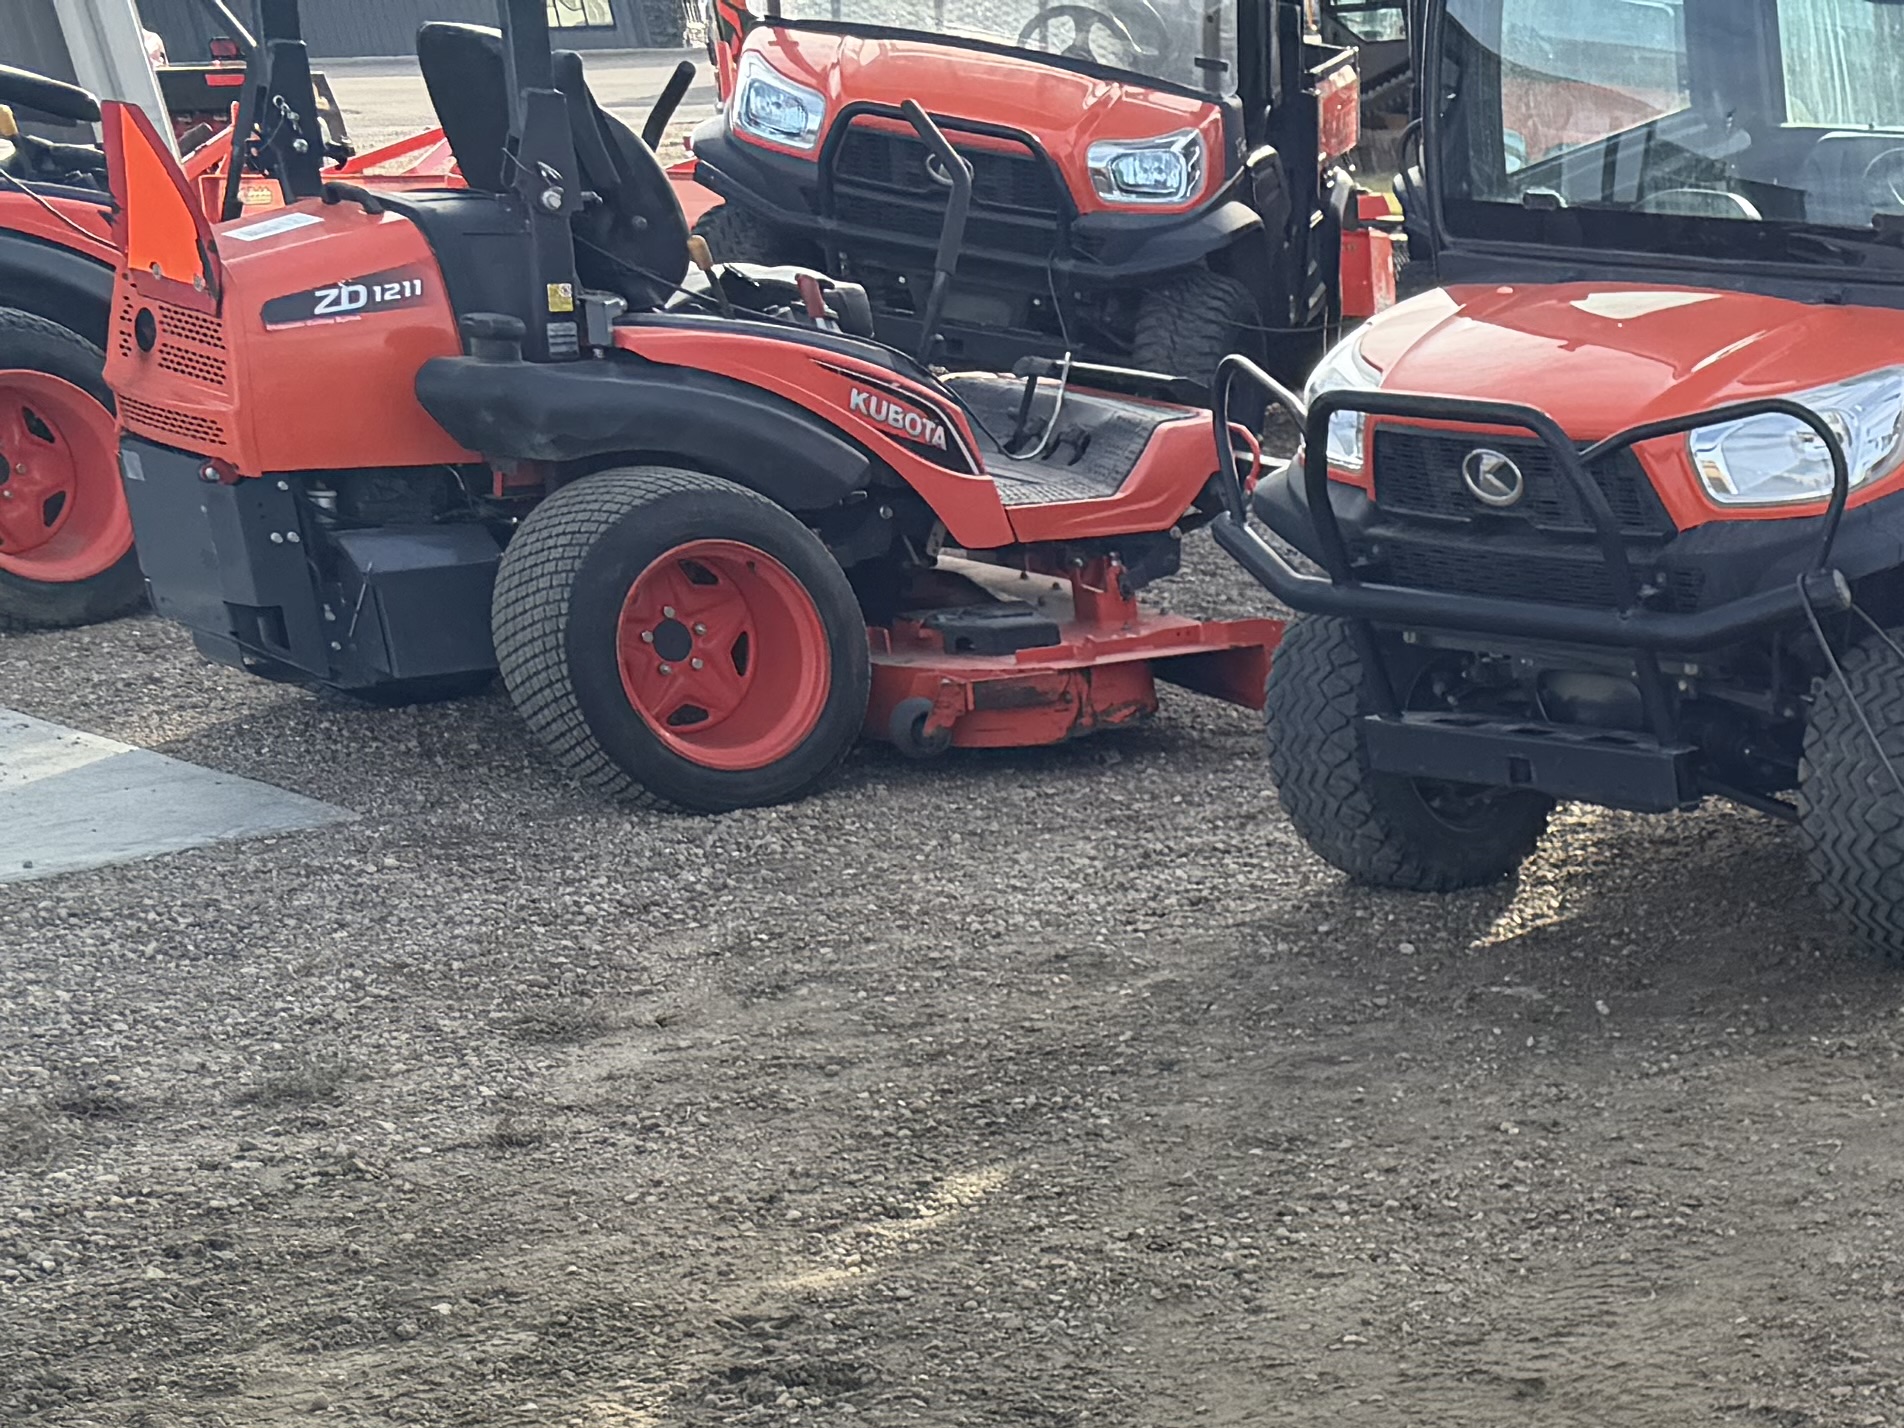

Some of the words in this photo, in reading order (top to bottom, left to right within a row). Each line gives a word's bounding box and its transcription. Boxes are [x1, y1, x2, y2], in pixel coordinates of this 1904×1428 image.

[313, 283, 368, 315] ZD
[374, 279, 422, 302] 1211
[849, 387, 948, 452] KUBOTA
